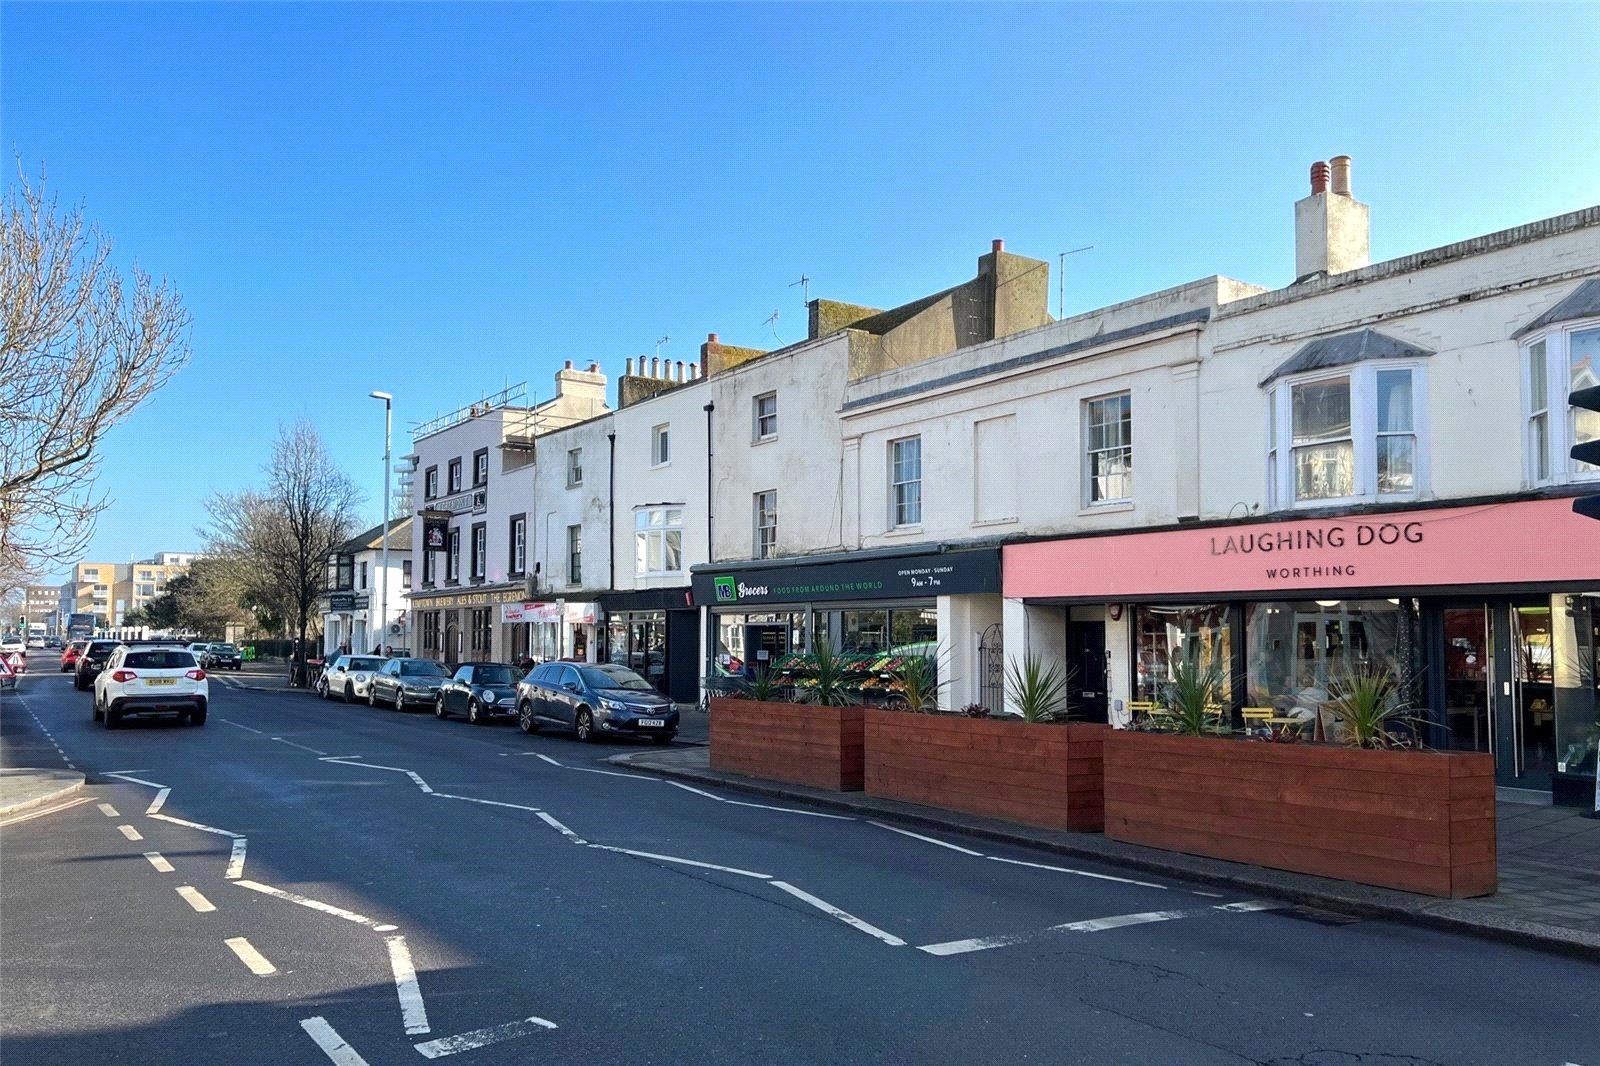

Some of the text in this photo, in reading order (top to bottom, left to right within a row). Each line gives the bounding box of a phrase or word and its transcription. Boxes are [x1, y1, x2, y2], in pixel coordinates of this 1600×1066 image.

[1211, 521, 1424, 556] LAUGHING DOG
[1266, 564, 1356, 579] WORTHING
[718, 584, 732, 599] MB
[737, 582, 769, 599] Grocers
[773, 581, 883, 595] FOOD FROM AROUND THE WORLD
[457, 596, 467, 605] ALES
[472, 594, 488, 604] STOUT
[491, 593, 500, 603] THE
[503, 591, 527, 603] EGREMON
